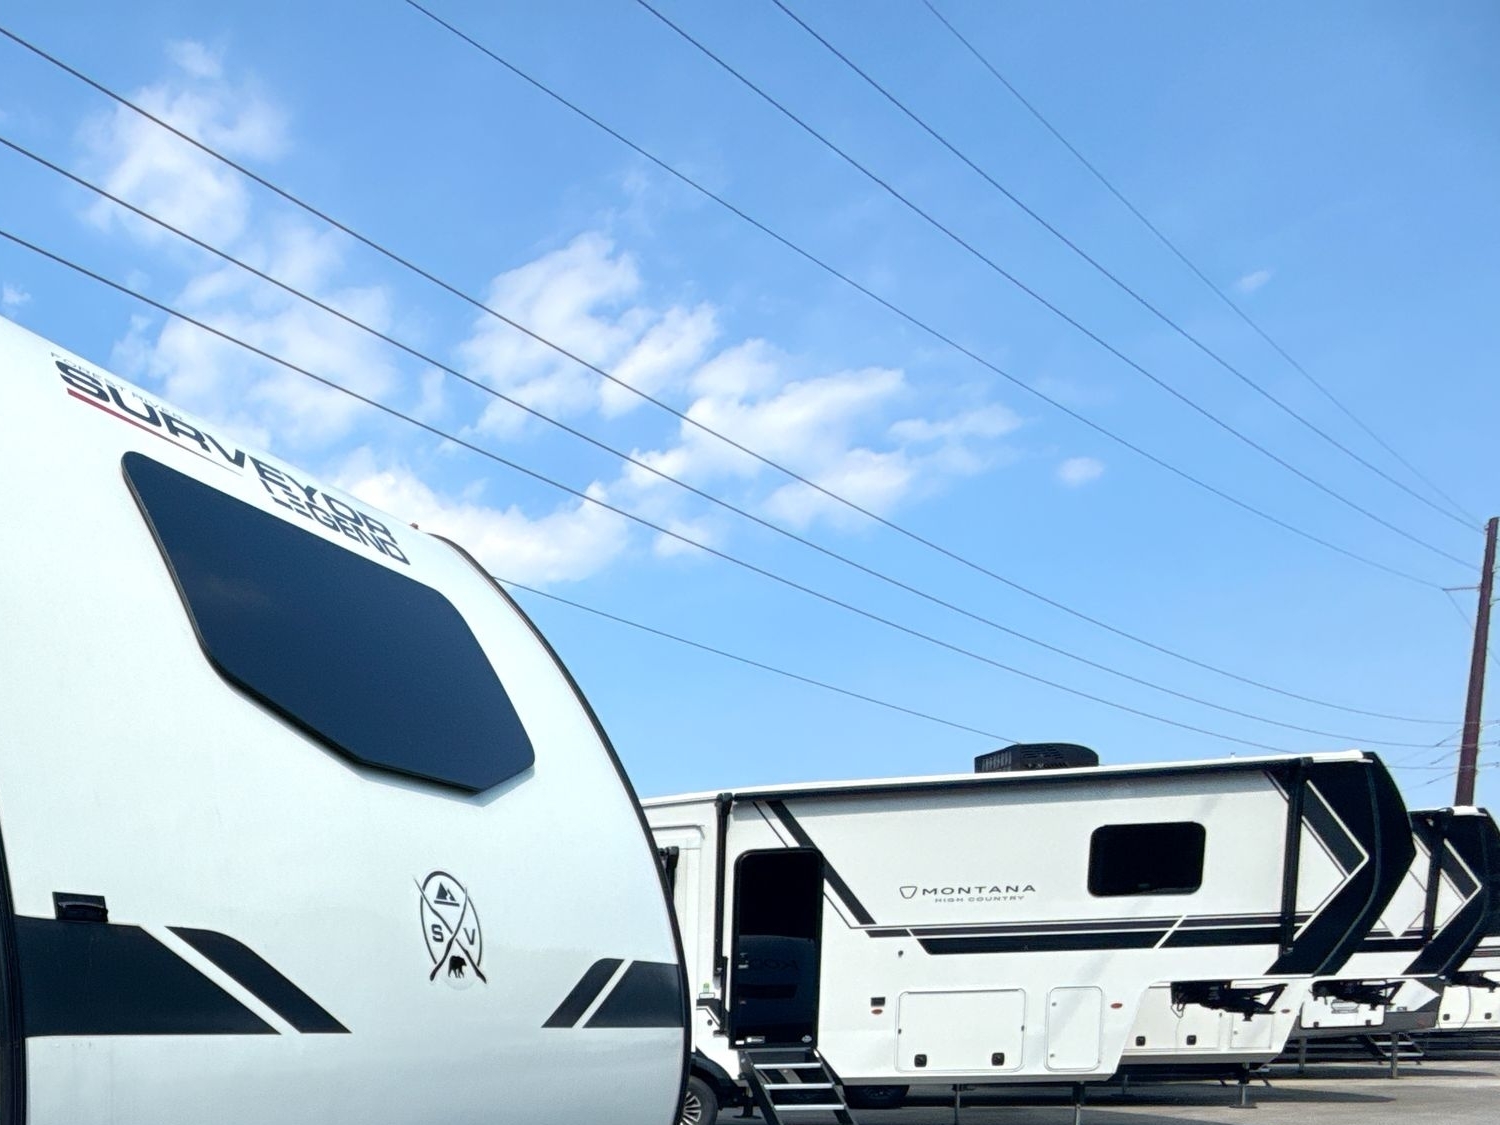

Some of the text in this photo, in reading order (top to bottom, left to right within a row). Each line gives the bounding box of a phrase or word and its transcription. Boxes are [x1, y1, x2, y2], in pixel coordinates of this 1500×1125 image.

[55, 360, 398, 546] SURVEYOR
[259, 478, 411, 566] LEGEND
[922, 885, 1036, 896] MONTANA
